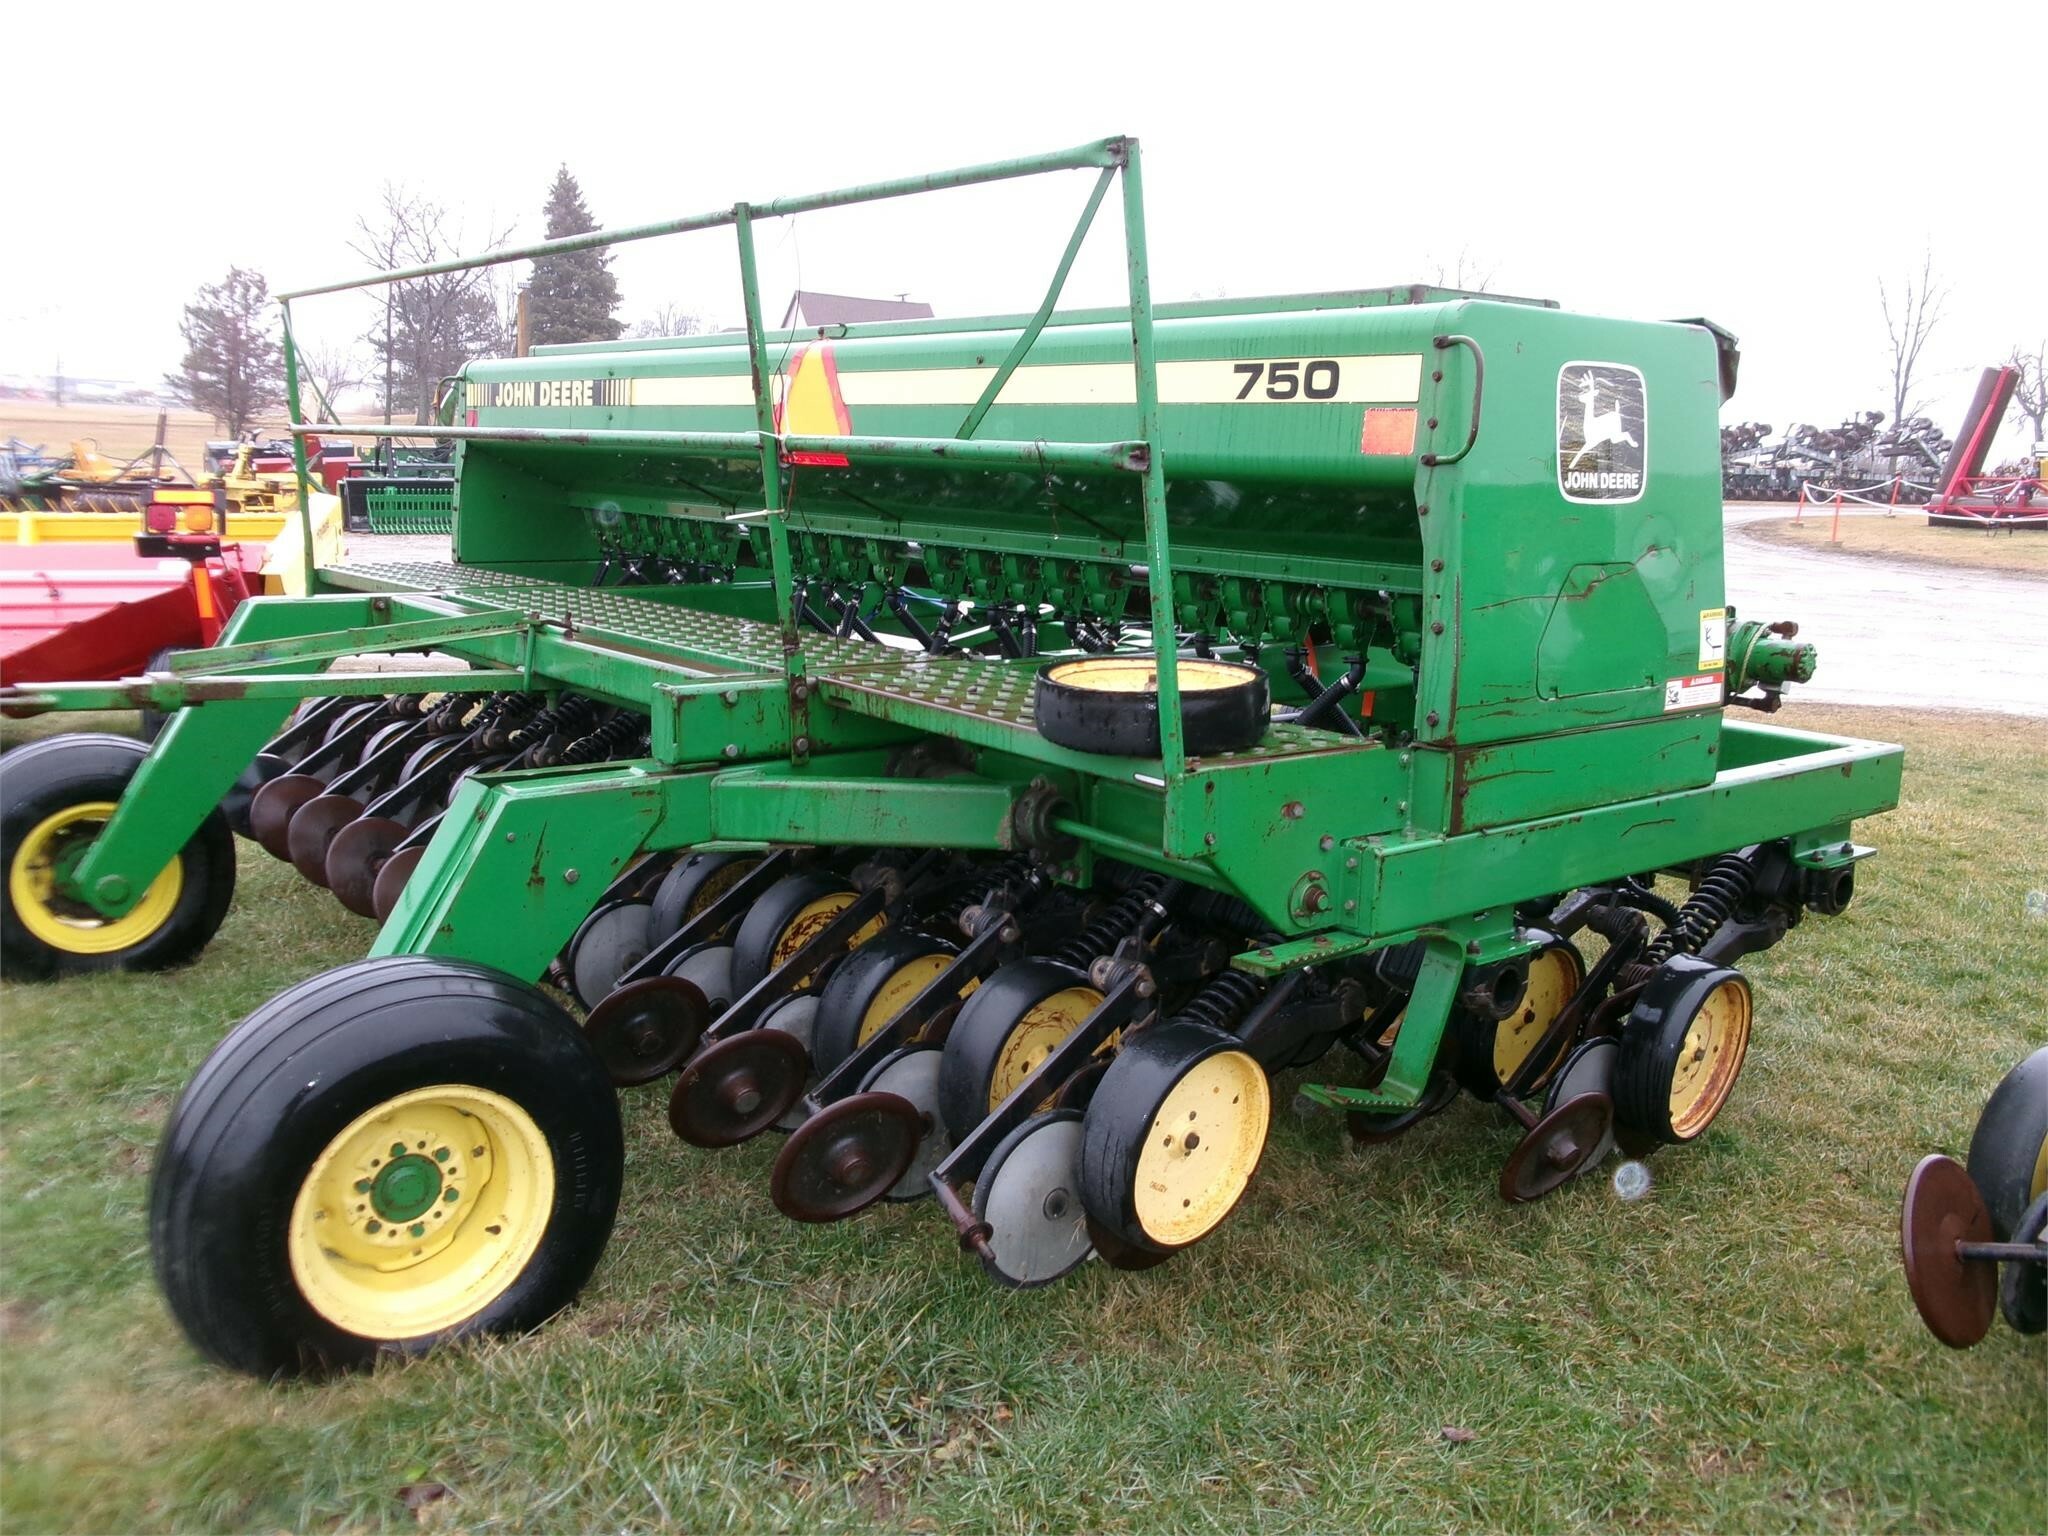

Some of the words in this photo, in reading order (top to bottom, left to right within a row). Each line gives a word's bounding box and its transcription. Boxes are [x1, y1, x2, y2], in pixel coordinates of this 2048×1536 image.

[495, 382, 535, 407] JOHN
[539, 379, 593, 406] DEERE
[1233, 360, 1340, 400] 750
[1564, 472, 1599, 489] JOHN
[1600, 472, 1640, 489] DEERE
